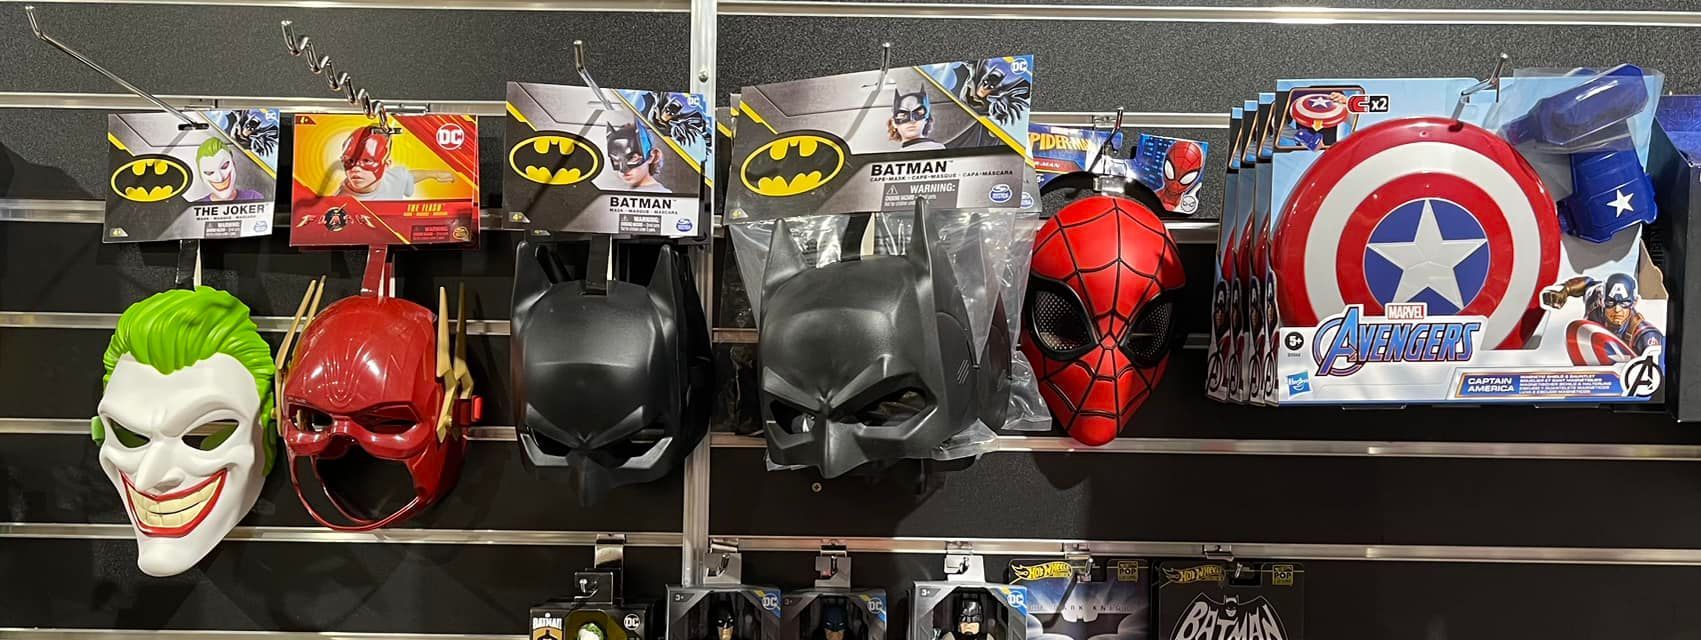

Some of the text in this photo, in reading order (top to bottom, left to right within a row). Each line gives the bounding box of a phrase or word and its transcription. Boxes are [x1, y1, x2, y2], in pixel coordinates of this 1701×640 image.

[1010, 58, 1027, 73] DC
[1371, 97, 1388, 110] x2
[437, 126, 464, 147] DC
[871, 161, 947, 176] BATMAN
[910, 183, 956, 194] WARNING:
[610, 197, 671, 208] BATMAN
[194, 204, 265, 216] THE JOKER
[1388, 305, 1424, 319] MARVEL
[1289, 335, 1303, 347] 5+
[1313, 306, 1482, 377] AVENGERS
[1468, 377, 1512, 385] CAPTAIN
[763, 595, 778, 608] DC
[867, 599, 882, 612] DC
[1008, 593, 1023, 606] DC
[624, 615, 640, 629] DC
[1174, 601, 1284, 640] BATMAN
